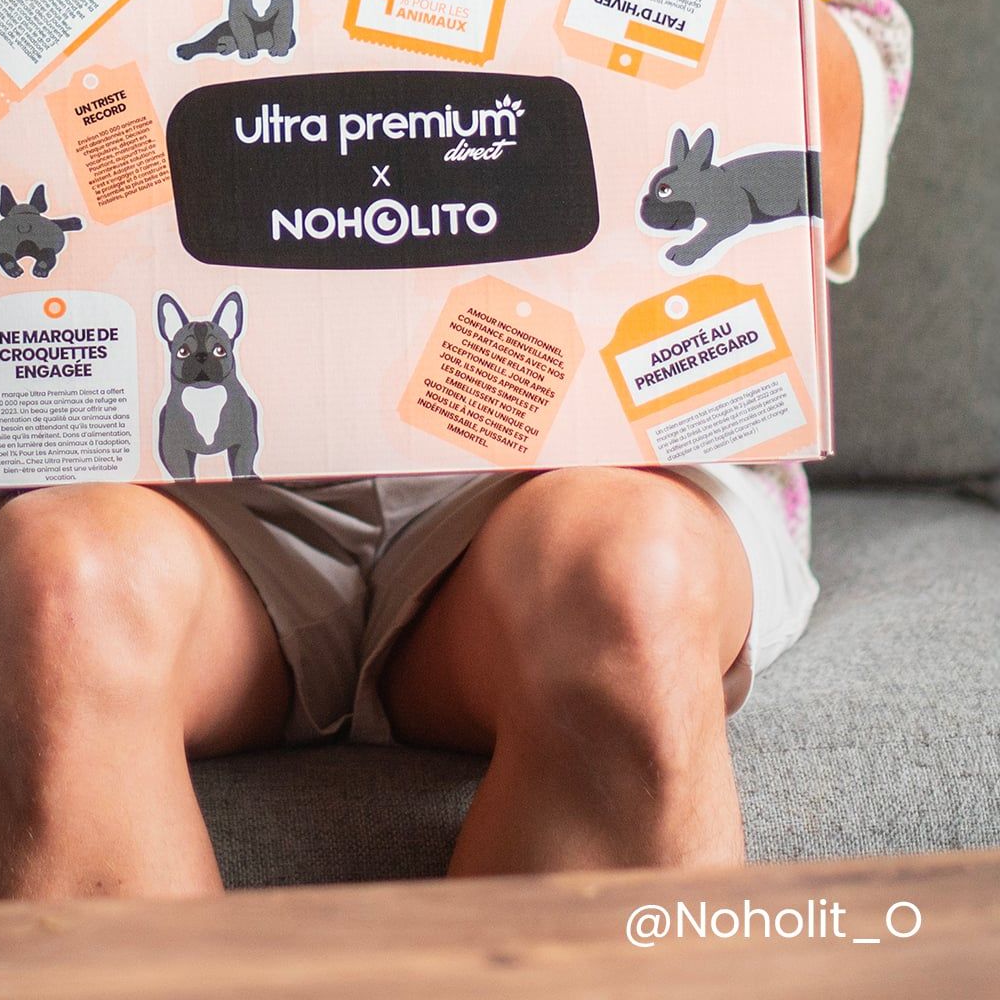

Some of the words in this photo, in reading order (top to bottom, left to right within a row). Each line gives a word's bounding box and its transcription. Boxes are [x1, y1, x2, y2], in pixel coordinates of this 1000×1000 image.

[396, 7, 466, 31] ANIMAUX
[448, 5, 468, 18] LES
[652, 12, 686, 31] FAIT
[74, 103, 92, 116] UN
[90, 89, 127, 109] TRISTE
[82, 103, 126, 126] RECORD
[235, 103, 327, 144] ultra
[340, 102, 518, 156] premium
[444, 139, 517, 161] direct
[271, 199, 498, 245] NOHOLITO
[22, 328, 95, 344] MARQUE
[97, 327, 118, 341] DE
[457, 314, 504, 342] CONFIANCE,
[505, 336, 564, 369] BIENVEILLANCE,
[466, 307, 497, 326] AMOUR
[496, 321, 563, 358] INCONDITIONNEL,
[651, 328, 710, 366] ADOPTÉ
[711, 322, 732, 341] AU
[0, 345, 107, 362] CROQUETTES
[449, 321, 473, 336] NOUS
[472, 332, 525, 361] PARTAGEONS
[524, 357, 547, 371] AVEC
[547, 367, 565, 380] NOS
[461, 338, 491, 357] CHIENS
[490, 351, 507, 364] UNE
[506, 359, 545, 382] RELATION
[634, 355, 698, 390] PREMIER
[697, 330, 758, 364] REGARD
[15, 360, 92, 379] ENGAGÉE
[439, 352, 462, 367] JOUR,
[463, 362, 475, 372] ILS
[475, 367, 498, 383] NOUS
[497, 379, 549, 406] APPRENNENT
[441, 340, 507, 376] EXCEPTIONNELLE.
[507, 372, 530, 387] JOUR
[529, 382, 555, 398] APRÈS
[53, 397, 83, 405] animaux
[94, 396, 117, 404] refuge
[79, 388, 99, 396] Direct
[440, 363, 455, 374] LES
[454, 369, 497, 394] BONHEURS
[496, 389, 529, 409] SIMPLES
[528, 404, 539, 413] ET
[445, 376, 500, 406] EMBELLISSENT
[499, 402, 526, 419] NOTRE
[31, 415, 42, 423] de
[42, 414, 67, 423] qualité
[69, 406, 86, 414] pour
[423, 378, 467, 404] QUOTIDIEN.
[468, 398, 477, 408] LE
[477, 403, 494, 415] LIEN
[494, 410, 524, 430] UNIQUE
[524, 425, 539, 436] QUI
[425, 390, 449, 405] NOUS
[448, 400, 460, 411] LIE
[459, 405, 466, 414] À
[466, 409, 484, 422] NOS
[484, 418, 514, 436] CHIENS
[513, 431, 528, 442] EST
[0, 424, 24, 432] besoin
[34, 423, 69, 431] attendant
[417, 397, 478, 432] INDÉFINISSABLE,
[479, 426, 518, 449] PUISSANT
[518, 444, 528, 453] ET
[446, 423, 488, 447] IMMORTEL.
[57, 439, 88, 447] animaux
[36, 465, 61, 473] animal
